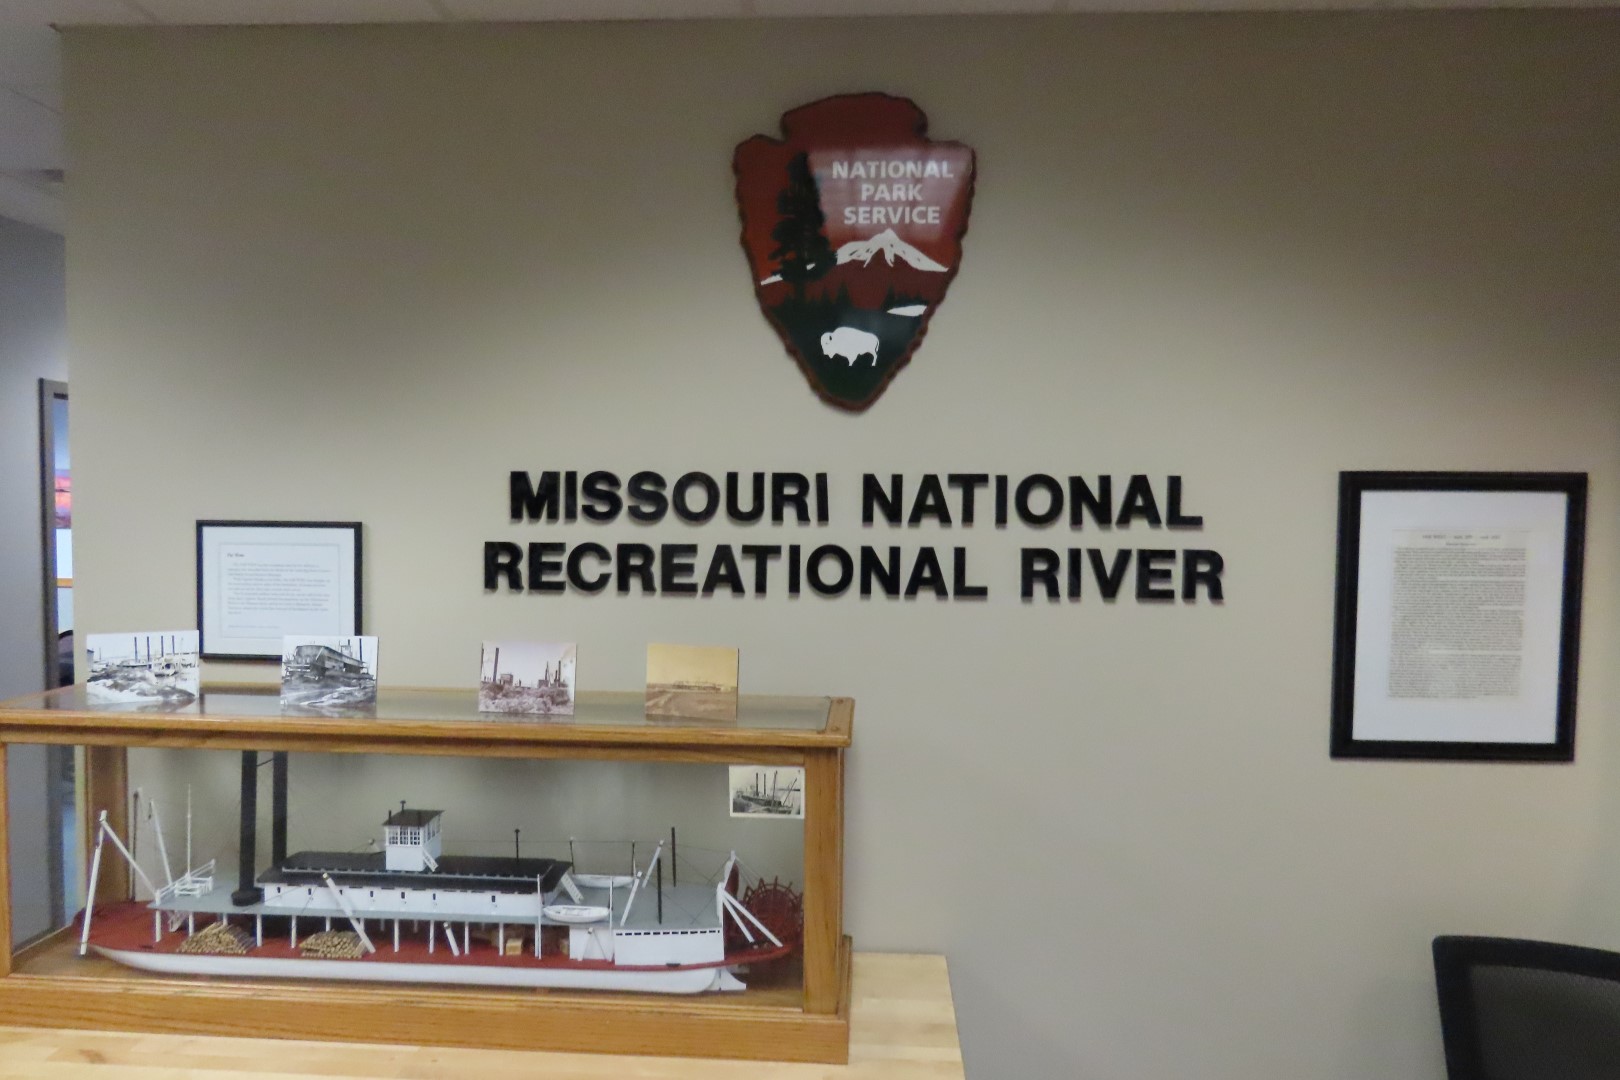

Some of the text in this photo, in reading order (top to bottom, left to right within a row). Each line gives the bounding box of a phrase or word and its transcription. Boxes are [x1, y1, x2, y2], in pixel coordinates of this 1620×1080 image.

[832, 161, 953, 179] NATIONAL
[861, 184, 922, 201] PARK
[844, 206, 940, 225] SERVICE
[510, 471, 1203, 529] MISSOURI NATIONAL
[485, 542, 1224, 603] RECREATIONAL RIVER
